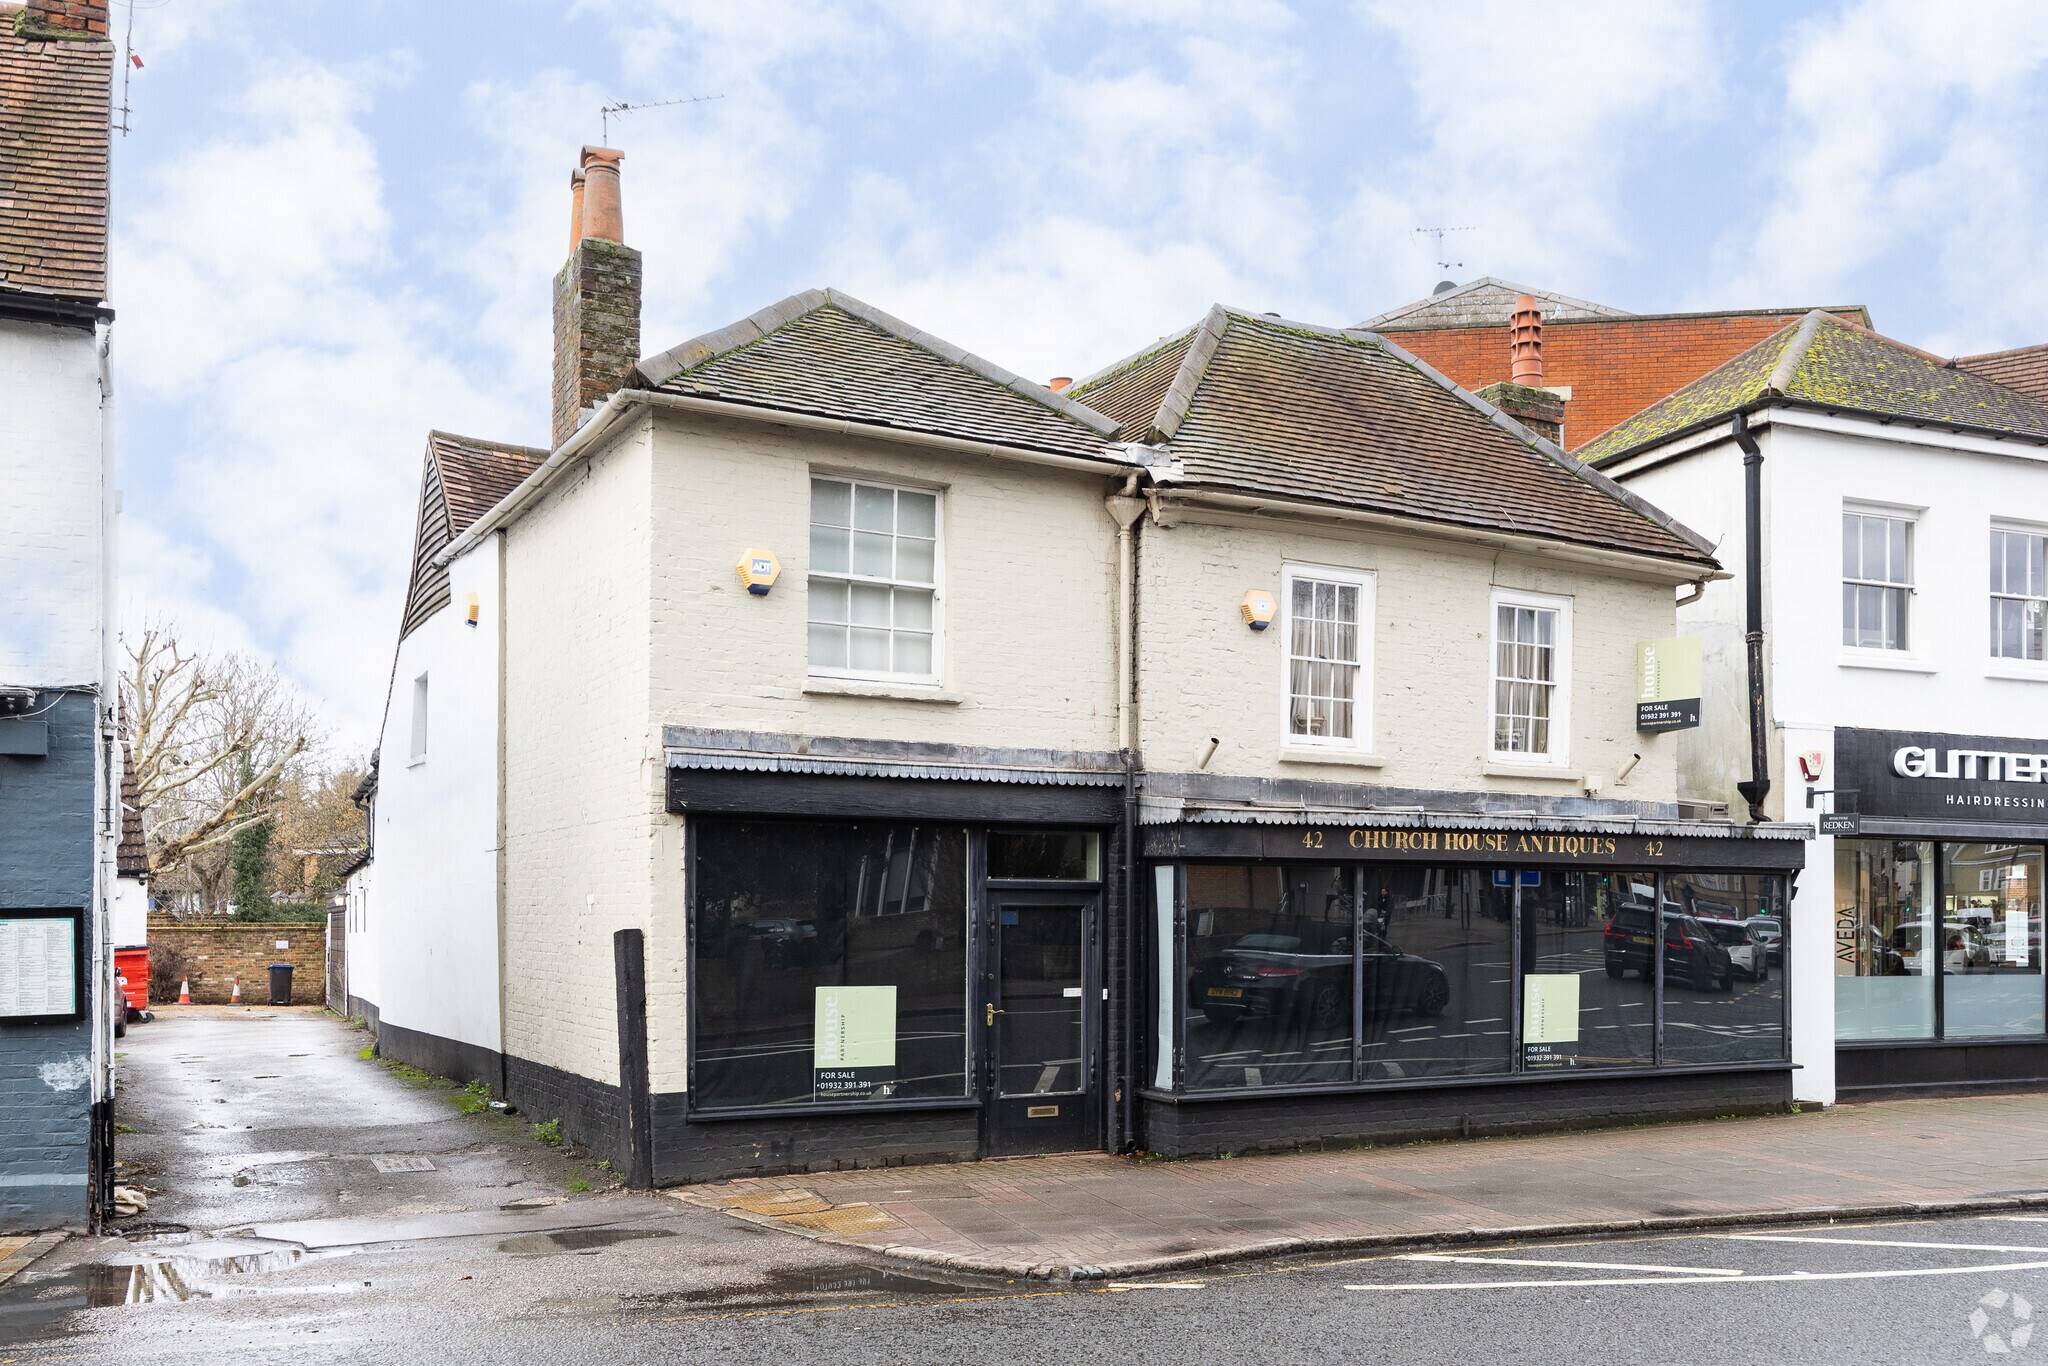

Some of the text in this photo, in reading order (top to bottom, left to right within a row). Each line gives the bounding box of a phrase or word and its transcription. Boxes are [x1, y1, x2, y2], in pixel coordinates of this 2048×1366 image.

[752, 561, 771, 573] ADT
[1946, 794, 2048, 809] HAIRDRESSIN
[1823, 821, 1854, 829] REDKEN
[1302, 830, 1664, 857] 42 CHURCH HOUSE ANTIQUES 42
[1836, 906, 1855, 964] AVEDA
[837, 1071, 855, 1079] SALE
